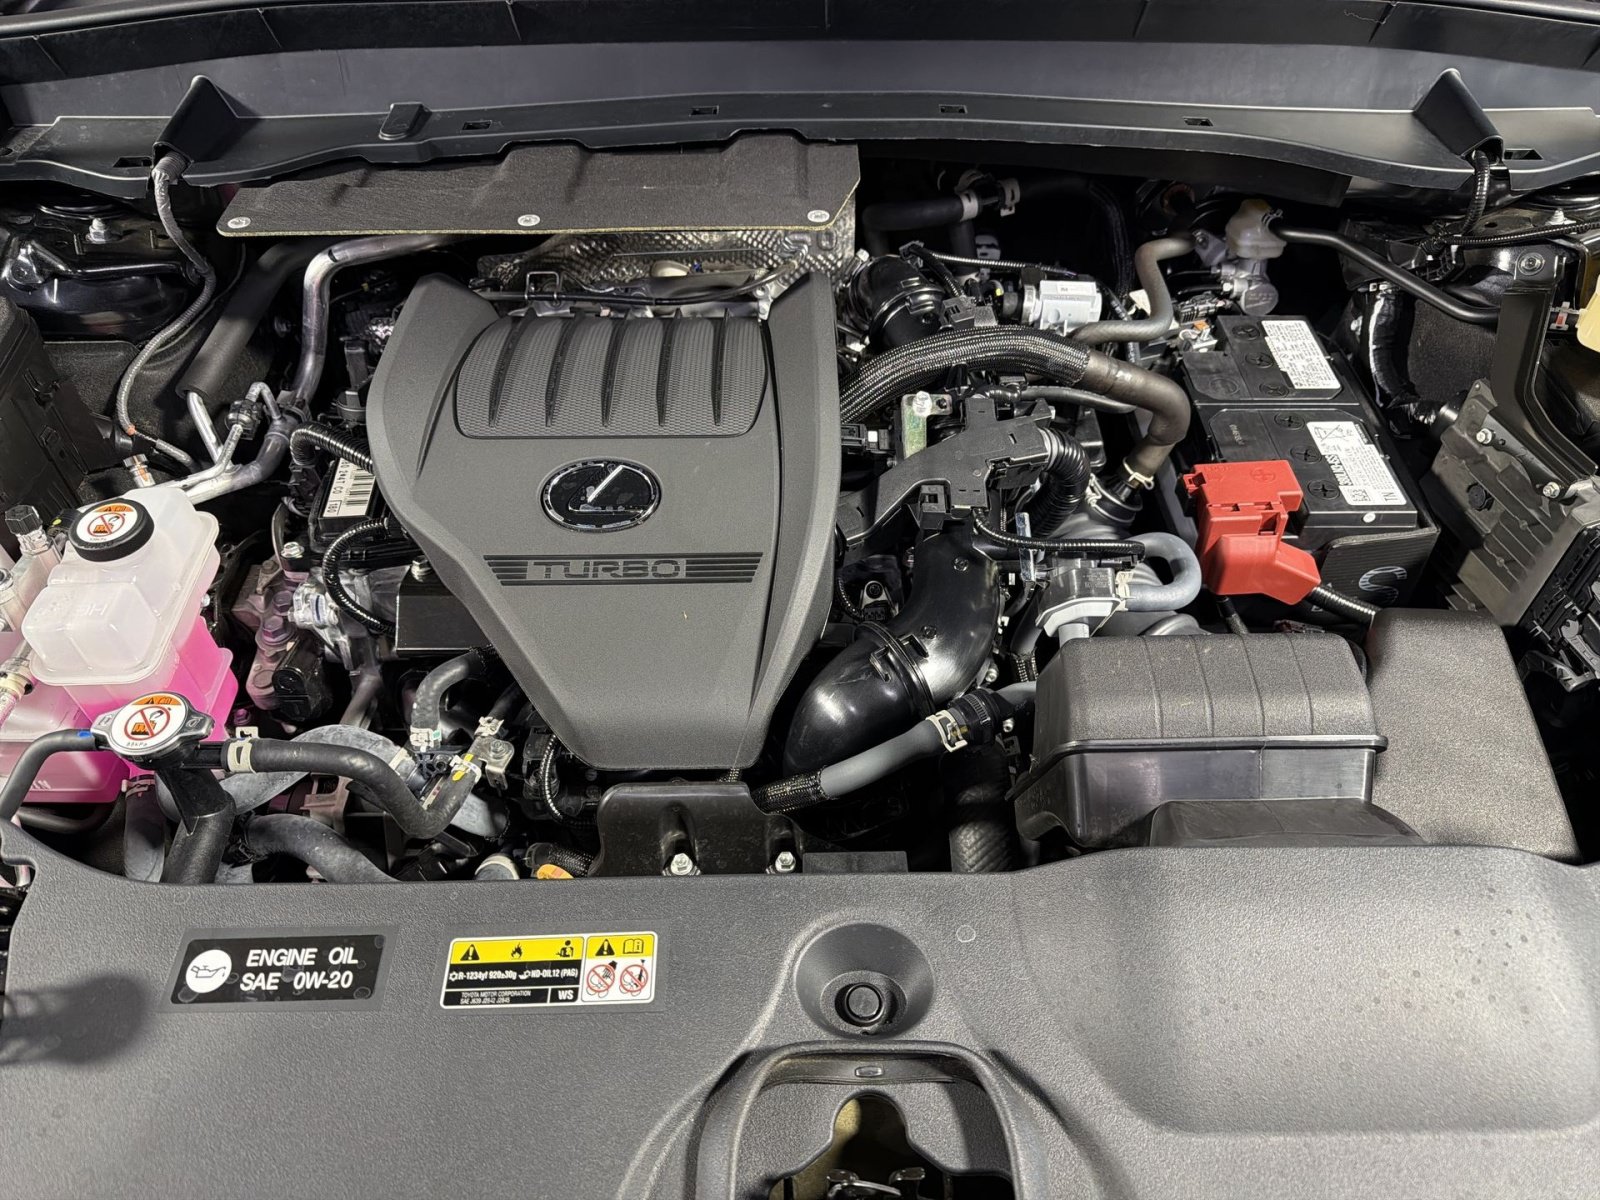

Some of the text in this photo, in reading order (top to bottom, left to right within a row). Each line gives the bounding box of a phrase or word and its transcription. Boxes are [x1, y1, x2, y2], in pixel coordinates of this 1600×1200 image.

[533, 559, 681, 579] TURBO
[246, 947, 359, 967] ENGINE OIL
[240, 970, 354, 991] SAE 0W-20
[461, 991, 480, 999] TOYOTA
[497, 990, 532, 998] CORPORATION
[558, 989, 574, 1000] WS
